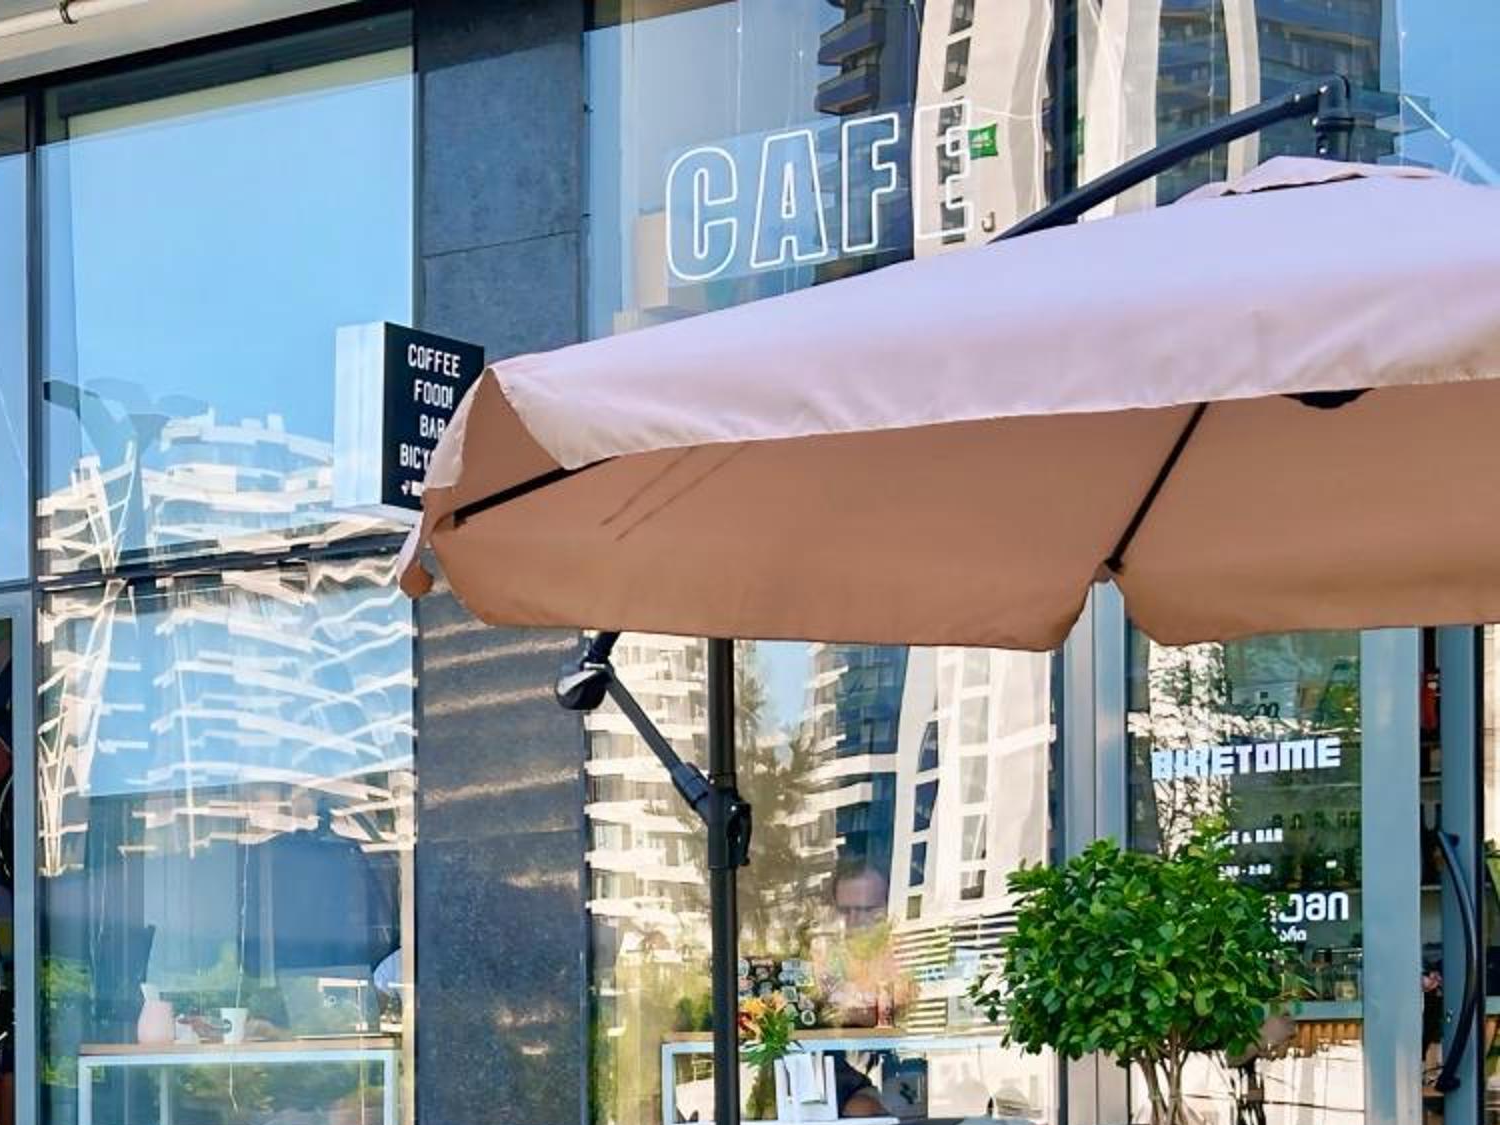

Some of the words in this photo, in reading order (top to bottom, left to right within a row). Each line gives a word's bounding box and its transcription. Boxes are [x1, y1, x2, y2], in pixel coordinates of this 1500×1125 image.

[665, 99, 973, 281] CAFE
[407, 343, 461, 378] COFFEE
[413, 379, 453, 410] FOOD!
[1151, 737, 1342, 779] BIKETOME
